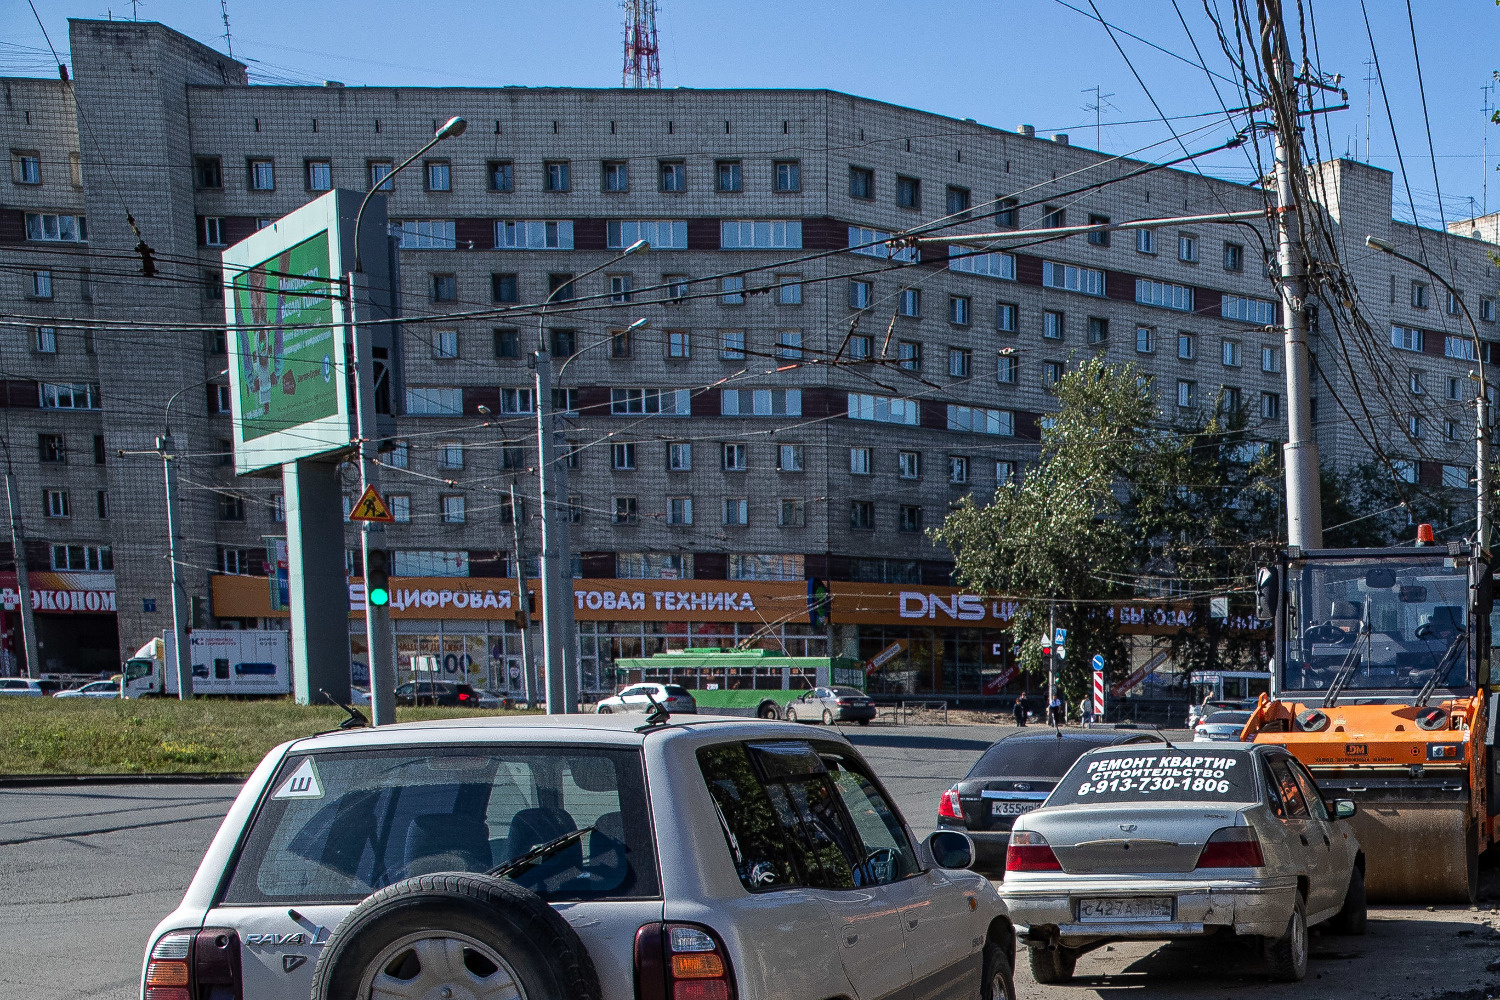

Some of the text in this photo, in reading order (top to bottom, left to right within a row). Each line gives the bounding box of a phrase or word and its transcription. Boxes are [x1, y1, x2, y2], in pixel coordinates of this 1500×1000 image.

[31, 590, 117, 611] ЭКОНОМ
[389, 588, 756, 611] ЦИФРОВАЯ ТОВАЯ ТЕХНИКА
[900, 591, 986, 621] DNS
[1087, 756, 1237, 774] РЕМОНТ КВАРТИР
[1091, 768, 1225, 781] СТРОИТЕЛЬСТВО
[290, 777, 312, 792] Ш
[1077, 777, 1230, 796] 8-913-730-1806
[245, 933, 305, 946] RAV4
